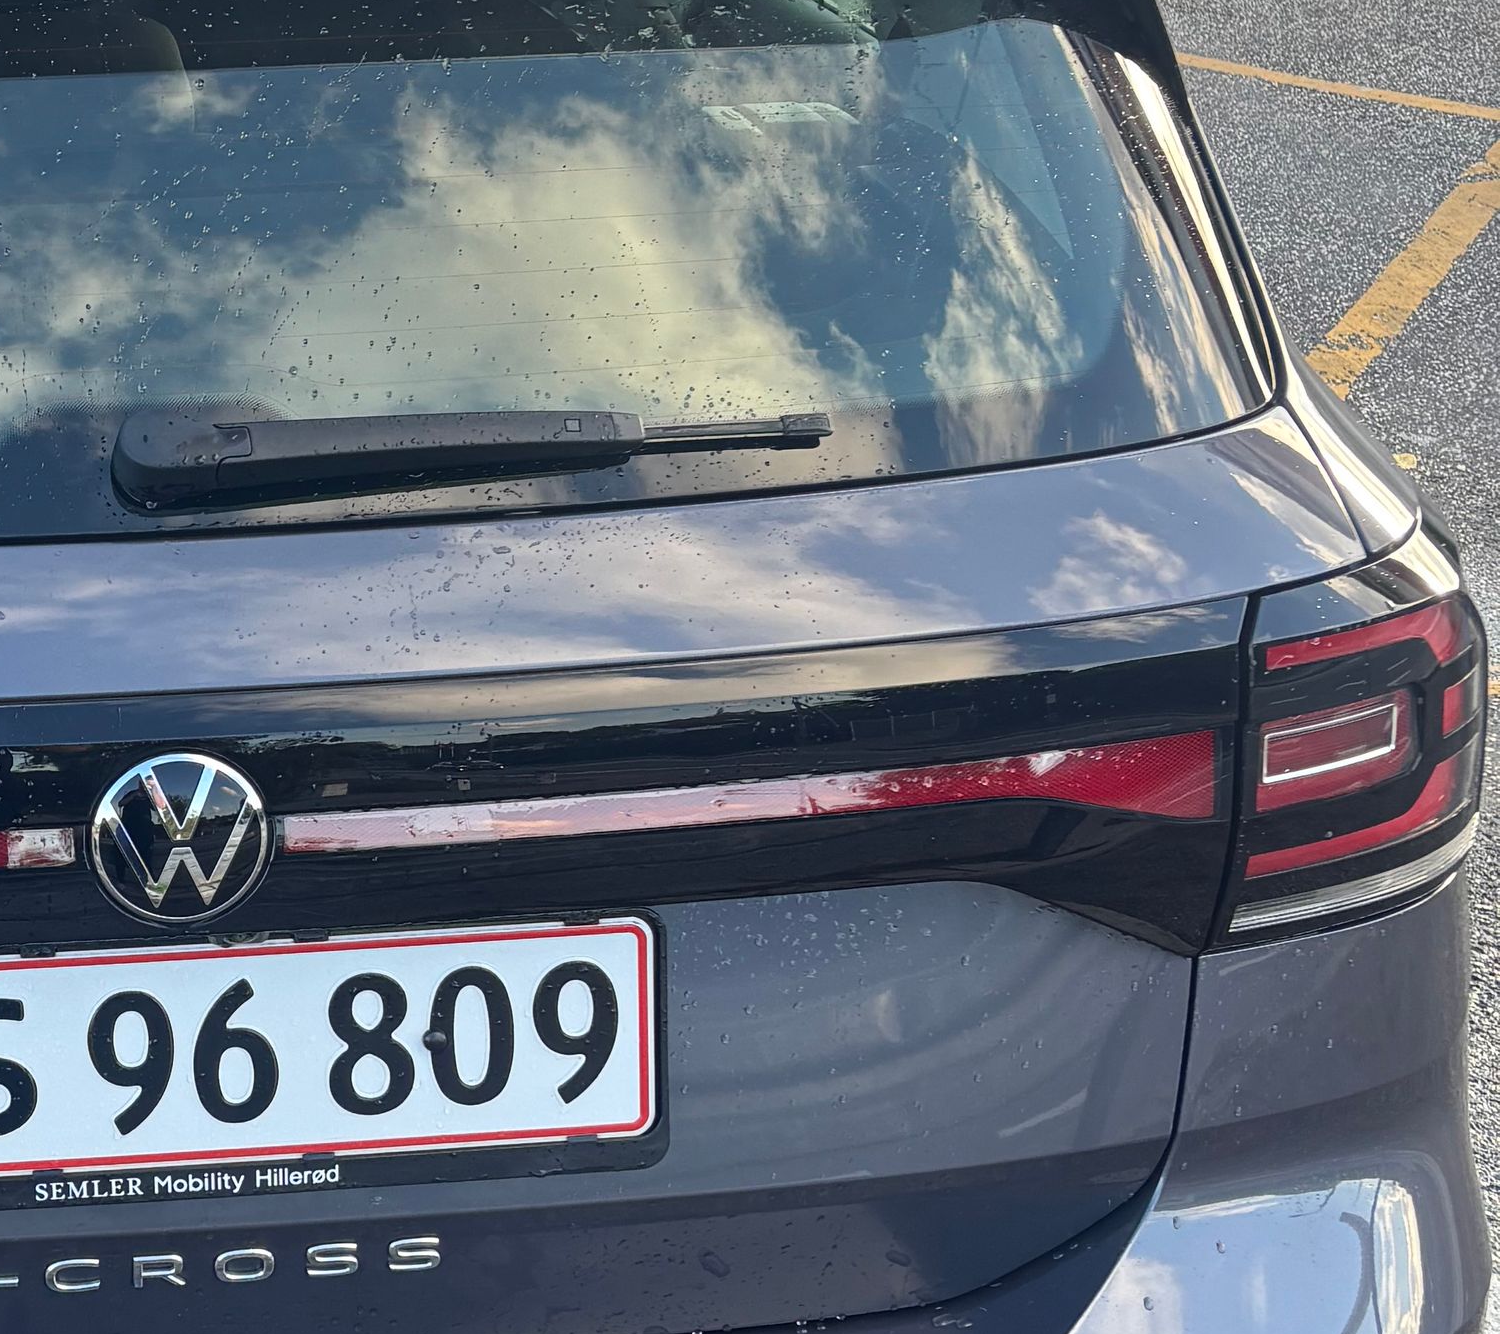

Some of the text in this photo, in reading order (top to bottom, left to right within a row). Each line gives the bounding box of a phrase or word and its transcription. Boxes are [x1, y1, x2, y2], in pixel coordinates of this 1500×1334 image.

[91, 754, 267, 919] VW
[87, 977, 280, 1137] 96
[327, 960, 620, 1117] 809
[34, 1163, 340, 1203] SEMLER Mobility Hillerød
